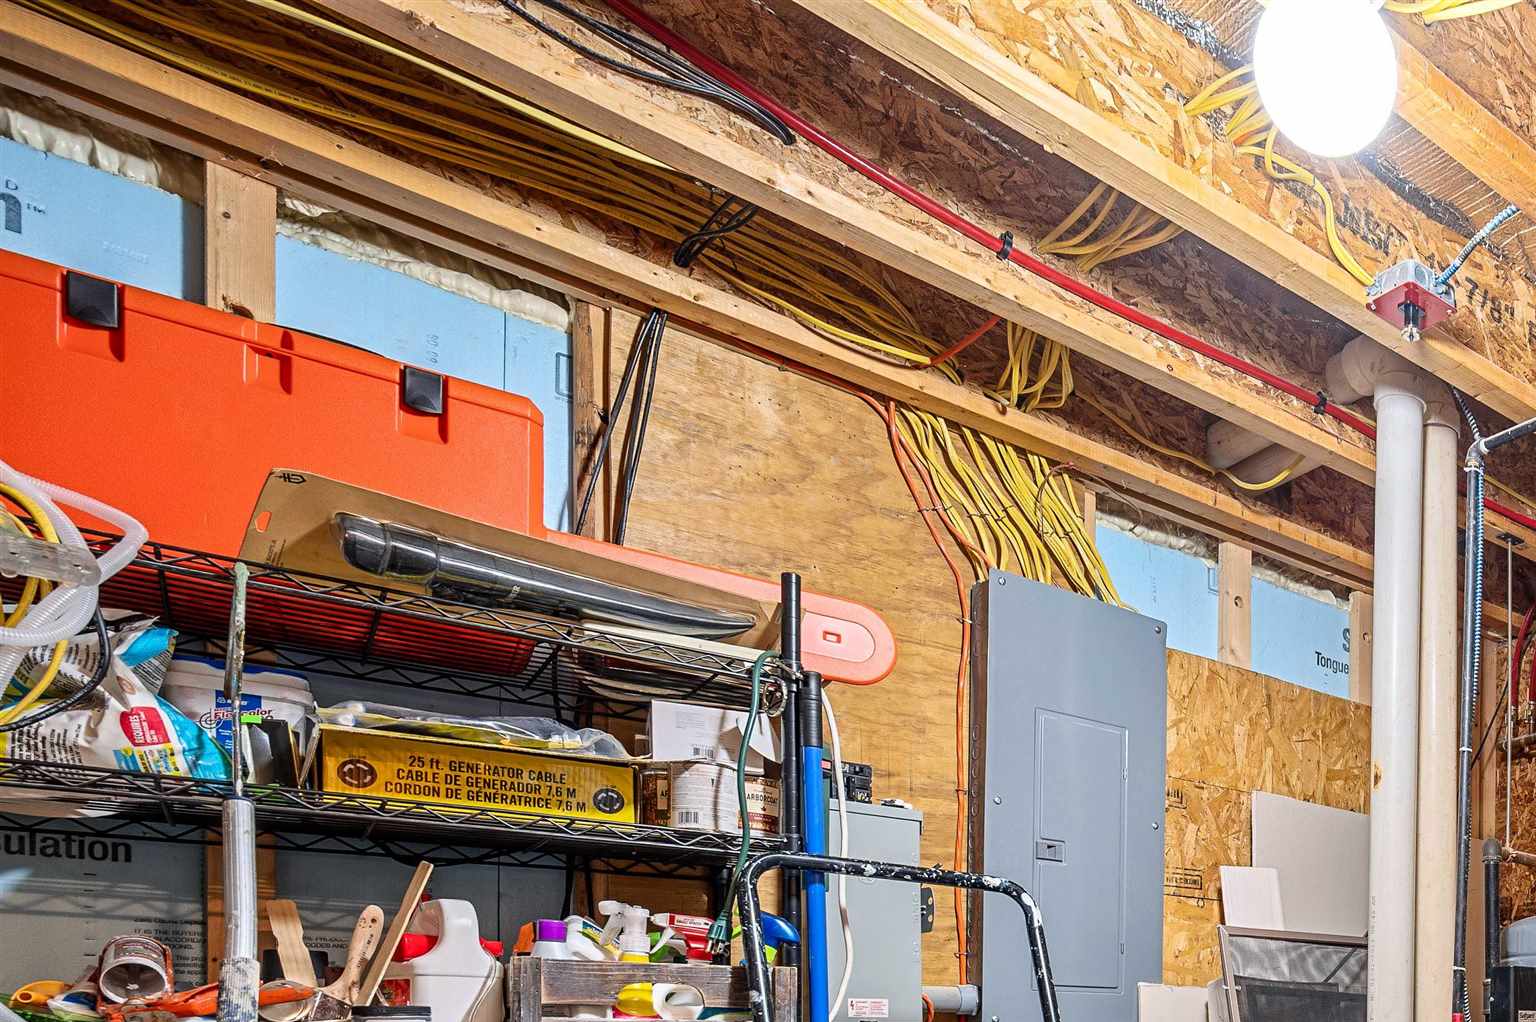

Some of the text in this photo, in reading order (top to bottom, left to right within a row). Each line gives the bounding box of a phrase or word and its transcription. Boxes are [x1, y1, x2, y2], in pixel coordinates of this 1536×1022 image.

[1315, 651, 1349, 674] Tongue
[396, 768, 577, 798] CABLE DE GENERADOR 7,6 M
[408, 755, 567, 785] 25 ft. GENERATOR CABLE
[384, 781, 587, 813] CORDON DE GÉNÉRATRICE 7,6 M
[0, 829, 132, 863] ulation
